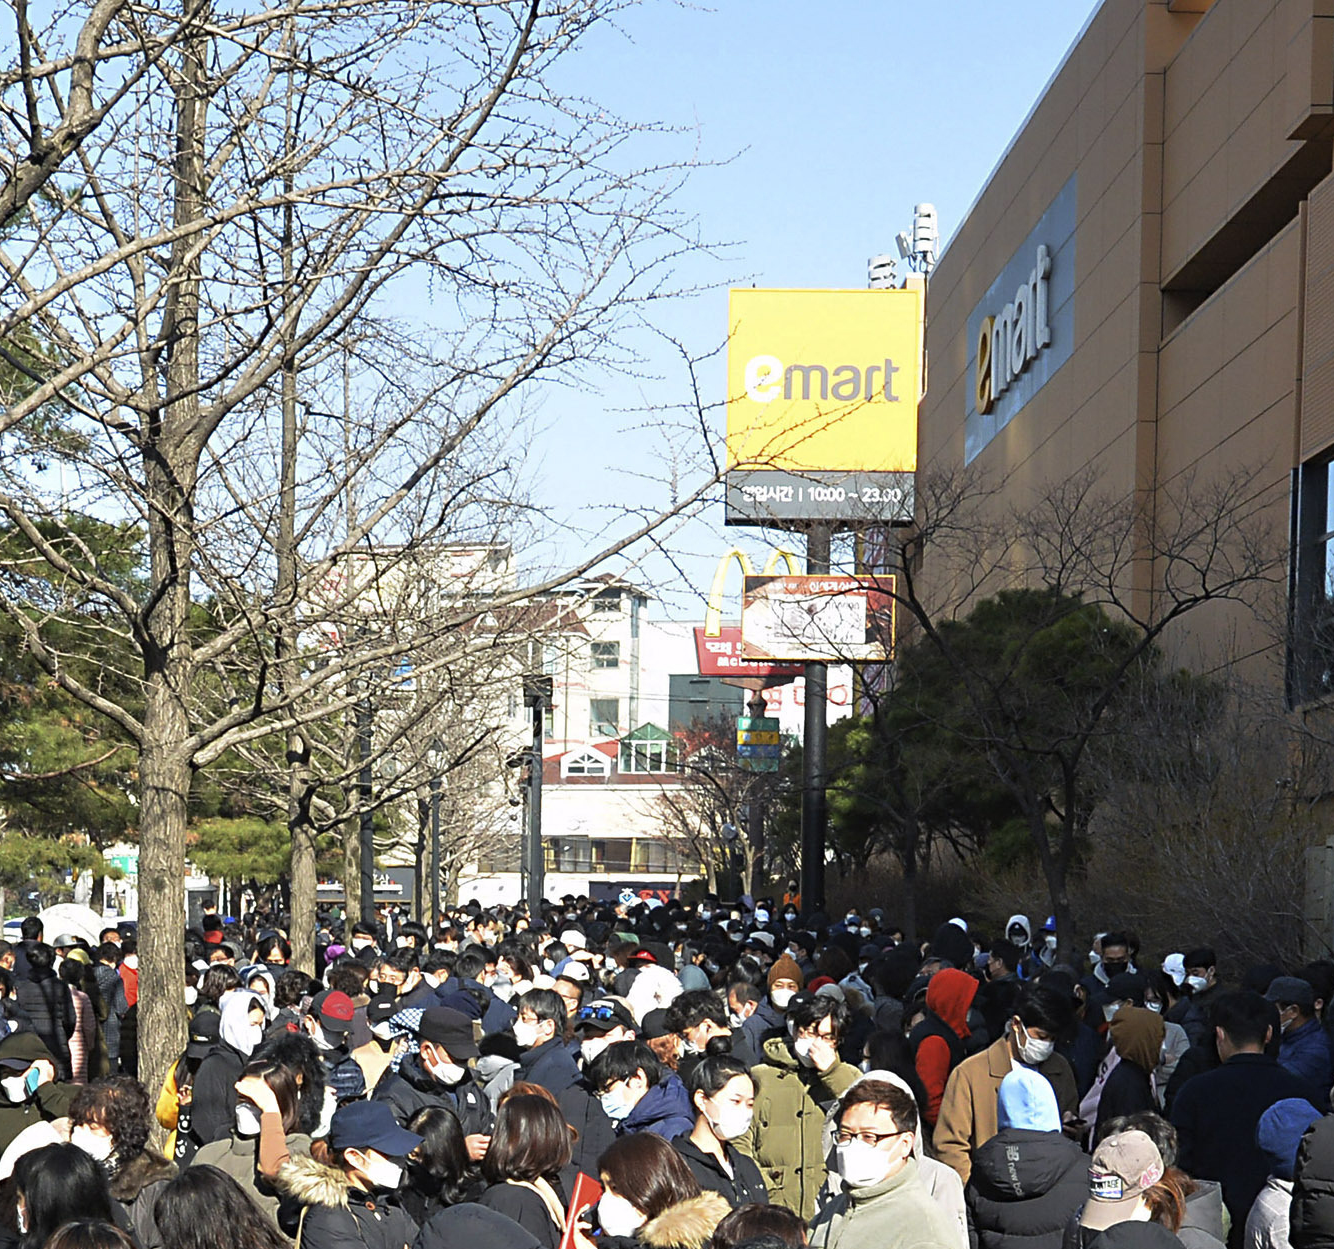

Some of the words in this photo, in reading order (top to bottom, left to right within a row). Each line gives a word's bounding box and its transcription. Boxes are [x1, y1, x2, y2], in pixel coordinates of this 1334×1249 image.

[976, 244, 1051, 415] emart
[745, 354, 900, 403] emart
[808, 486, 845, 501] 10:00
